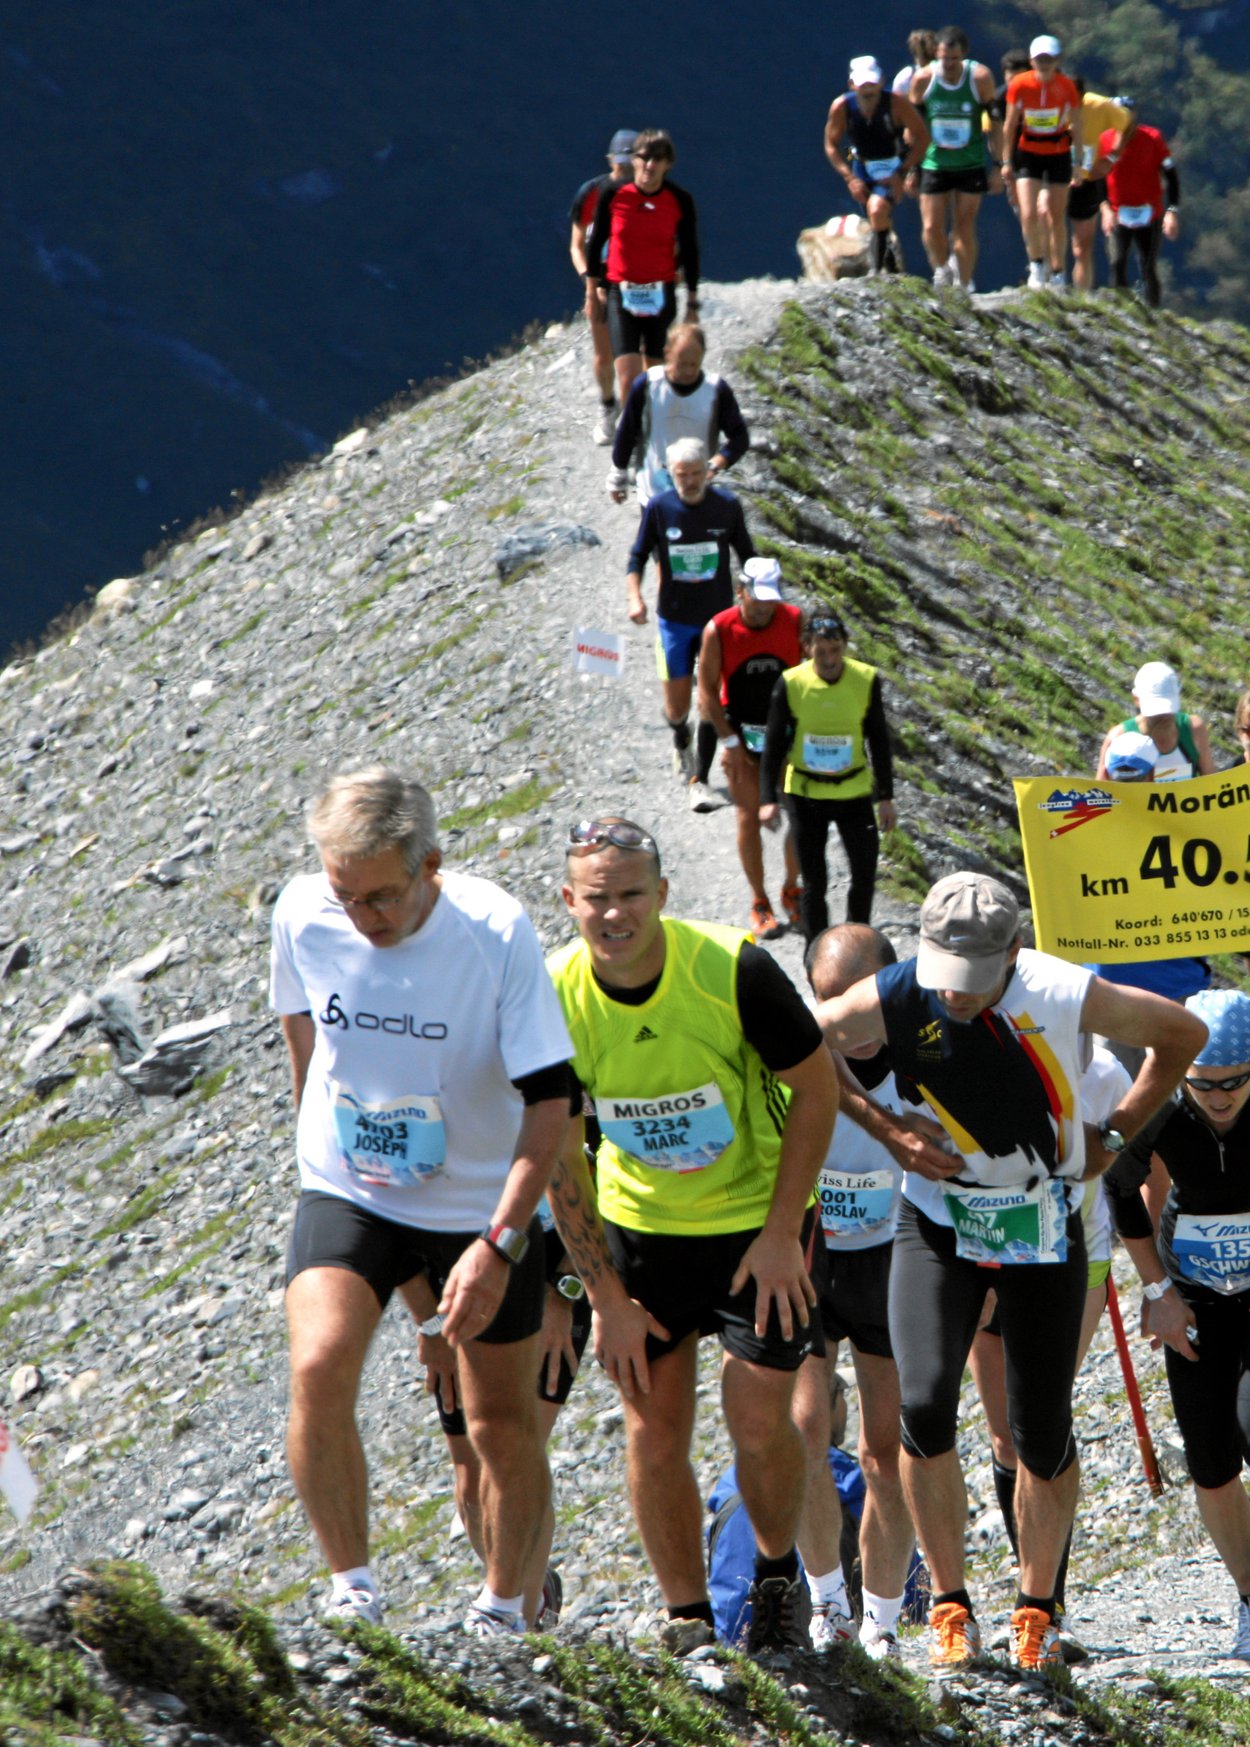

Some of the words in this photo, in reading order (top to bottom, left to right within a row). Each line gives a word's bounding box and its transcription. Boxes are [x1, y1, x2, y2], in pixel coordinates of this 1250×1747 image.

[1080, 874, 1129, 897] km
[1115, 915, 1163, 930] Koord:
[1172, 909, 1224, 925] 640'670
[1228, 909, 1234, 922] /
[1057, 938, 1129, 950] Notfall-Nr.
[1134, 935, 1161, 947] 033
[1166, 930, 1192, 943] 855
[1196, 928, 1210, 941] 13
[1214, 927, 1227, 939] 13
[355, 1012, 448, 1040] odlo
[613, 1092, 706, 1118] MIGROS
[632, 1115, 690, 1136] 3234
[353, 1133, 408, 1160] JOSEPH
[643, 1131, 689, 1152] MARC
[847, 1177, 876, 1188] Life
[960, 1218, 1005, 1243] MARTIN
